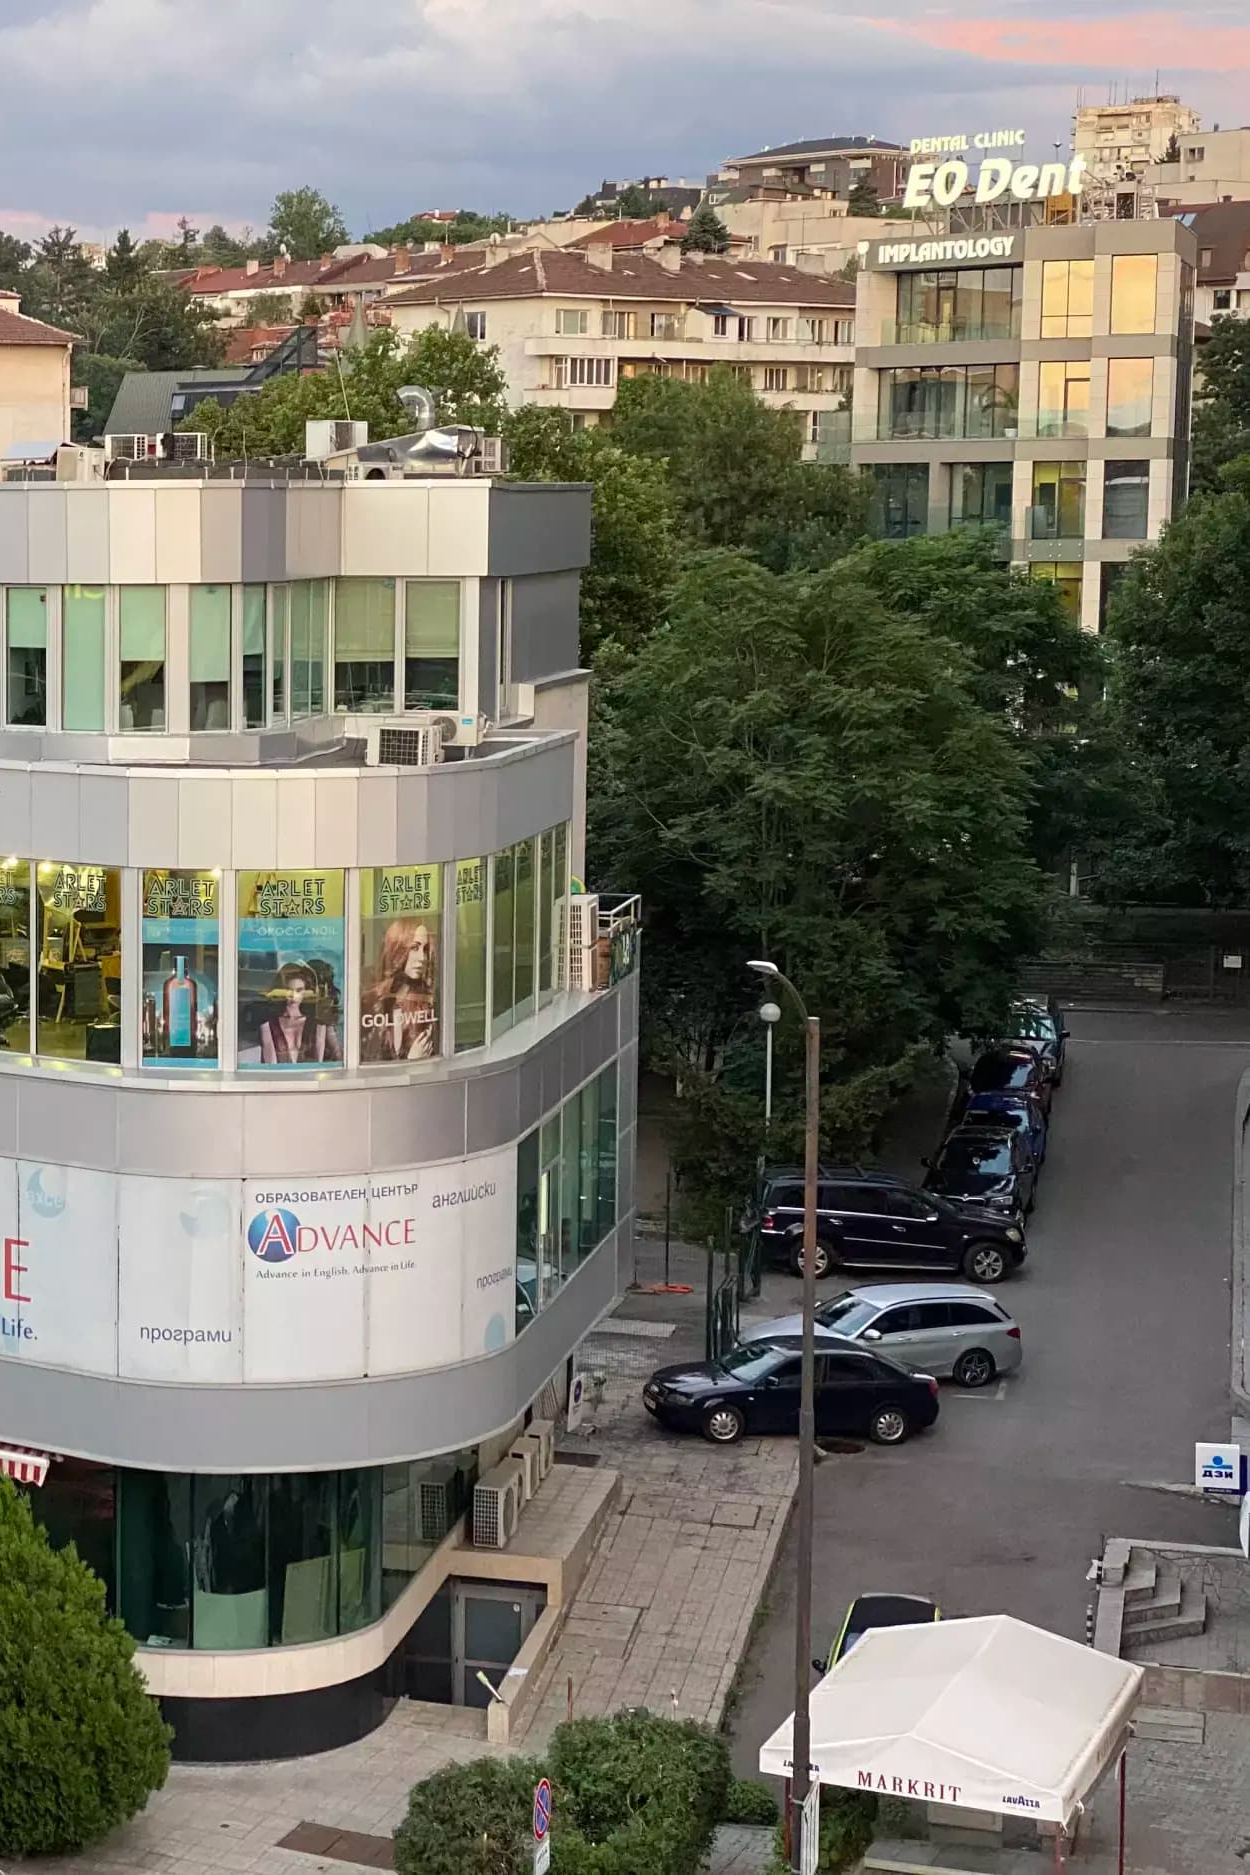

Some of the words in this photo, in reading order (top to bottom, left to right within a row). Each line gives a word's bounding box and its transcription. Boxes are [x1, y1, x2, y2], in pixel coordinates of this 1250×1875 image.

[910, 134, 969, 155] DENTAL
[973, 129, 1025, 150] CLINIC
[902, 160, 968, 209] EO
[974, 153, 1087, 205] Dent
[877, 235, 1015, 265] IMPLANTOLOGY
[54, 872, 107, 893] ARLET
[149, 878, 215, 898] ARLET
[259, 878, 326, 898] ARLET
[380, 873, 431, 893] ARLET
[53, 890, 107, 912] STARS
[148, 897, 214, 916] STARS
[260, 897, 326, 916] STARS
[378, 892, 431, 913] STARS
[361, 1008, 439, 1028] GOLDWELL
[255, 1188, 367, 1204] ОБРАЗОВАТЕЛЕН
[371, 1183, 418, 1199] ЦЕНТЪР
[432, 1180, 497, 1209] английски
[256, 1214, 417, 1256] ADVANCE
[256, 1269, 299, 1280] Advance
[302, 1268, 311, 1278] in
[352, 1263, 389, 1275] Advance
[476, 1267, 514, 1290] програми
[2, 1318, 39, 1341] Life.
[139, 1325, 233, 1345] програми
[1202, 1469, 1233, 1480] ДЗИ
[856, 1770, 963, 1803] MARKRIT
[1002, 1795, 1041, 1809] LAVAZZA
